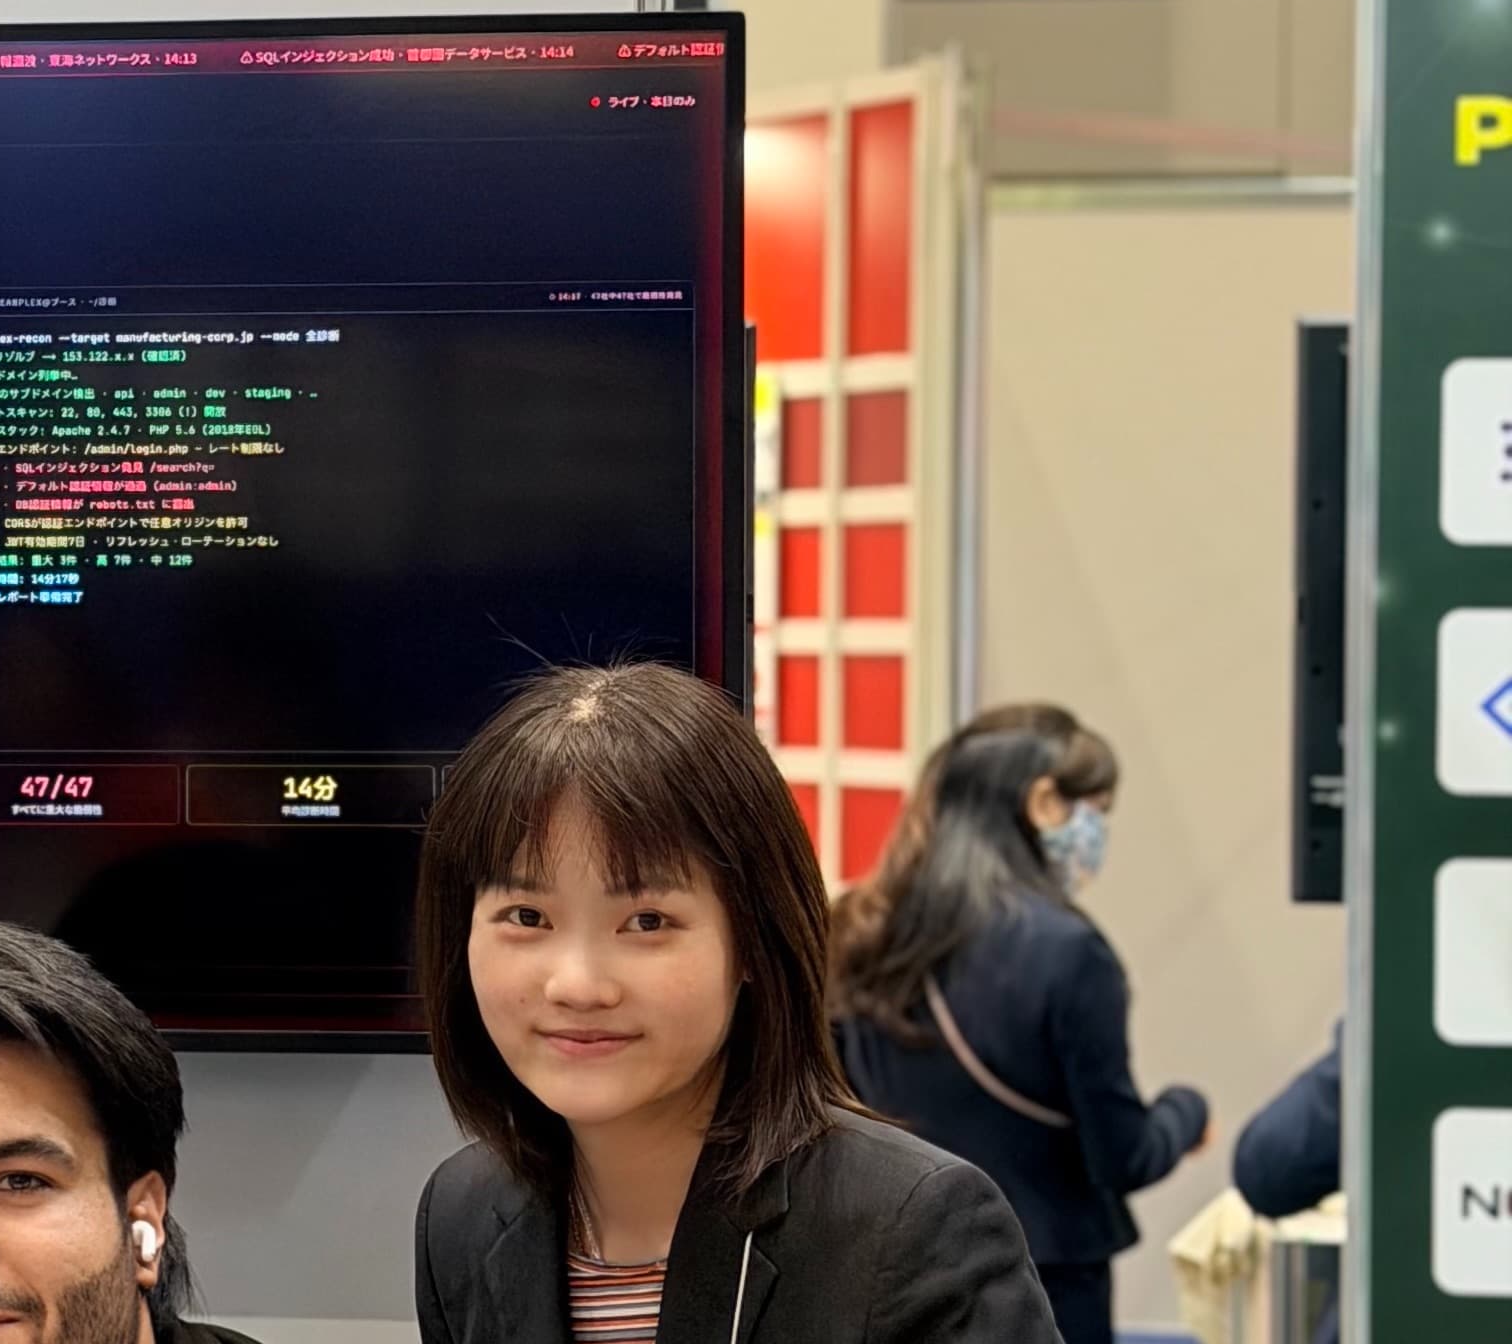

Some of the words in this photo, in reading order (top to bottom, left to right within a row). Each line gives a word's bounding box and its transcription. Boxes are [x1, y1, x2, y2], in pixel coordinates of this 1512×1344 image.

[164, 53, 197, 65] 14:13
[540, 45, 574, 59] 14:14
[116, 331, 254, 344] manufacturing-corp.jp
[245, 387, 292, 401] staging
[52, 425, 91, 438] Apache
[90, 498, 155, 510] robots.txt
[21, 774, 94, 800] 47/47
[283, 776, 338, 801] 14分
